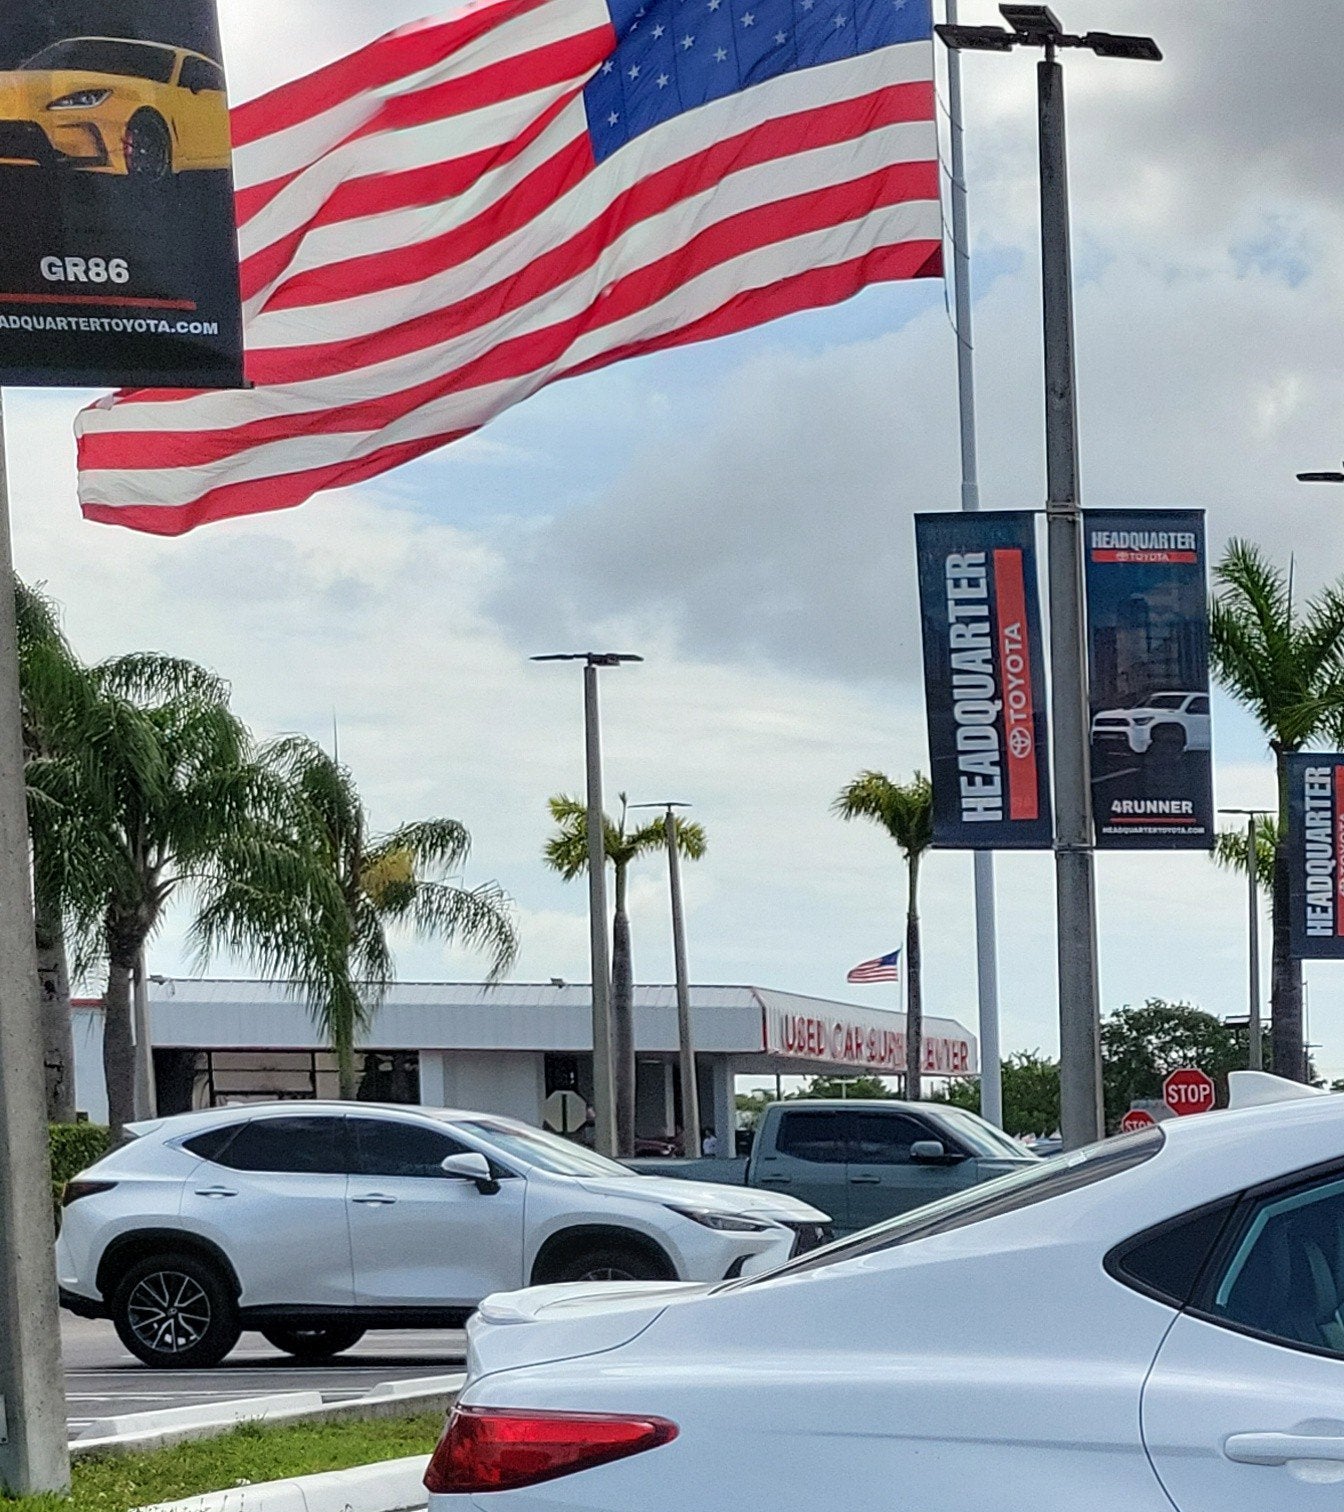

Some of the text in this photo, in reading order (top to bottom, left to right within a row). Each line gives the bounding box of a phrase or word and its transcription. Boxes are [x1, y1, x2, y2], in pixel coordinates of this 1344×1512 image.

[40, 256, 130, 284] GR86
[1091, 531, 1196, 551] HEADQUARTER
[1130, 552, 1170, 562] TOYOTA
[945, 551, 1003, 822] HEADQUARTER
[1004, 622, 1027, 724] TOYOTA
[1111, 800, 1193, 814] 4RUNNER
[1305, 766, 1337, 936] HEADQUARTER
[783, 1013, 825, 1055] USED
[1168, 1084, 1210, 1104] STOP
